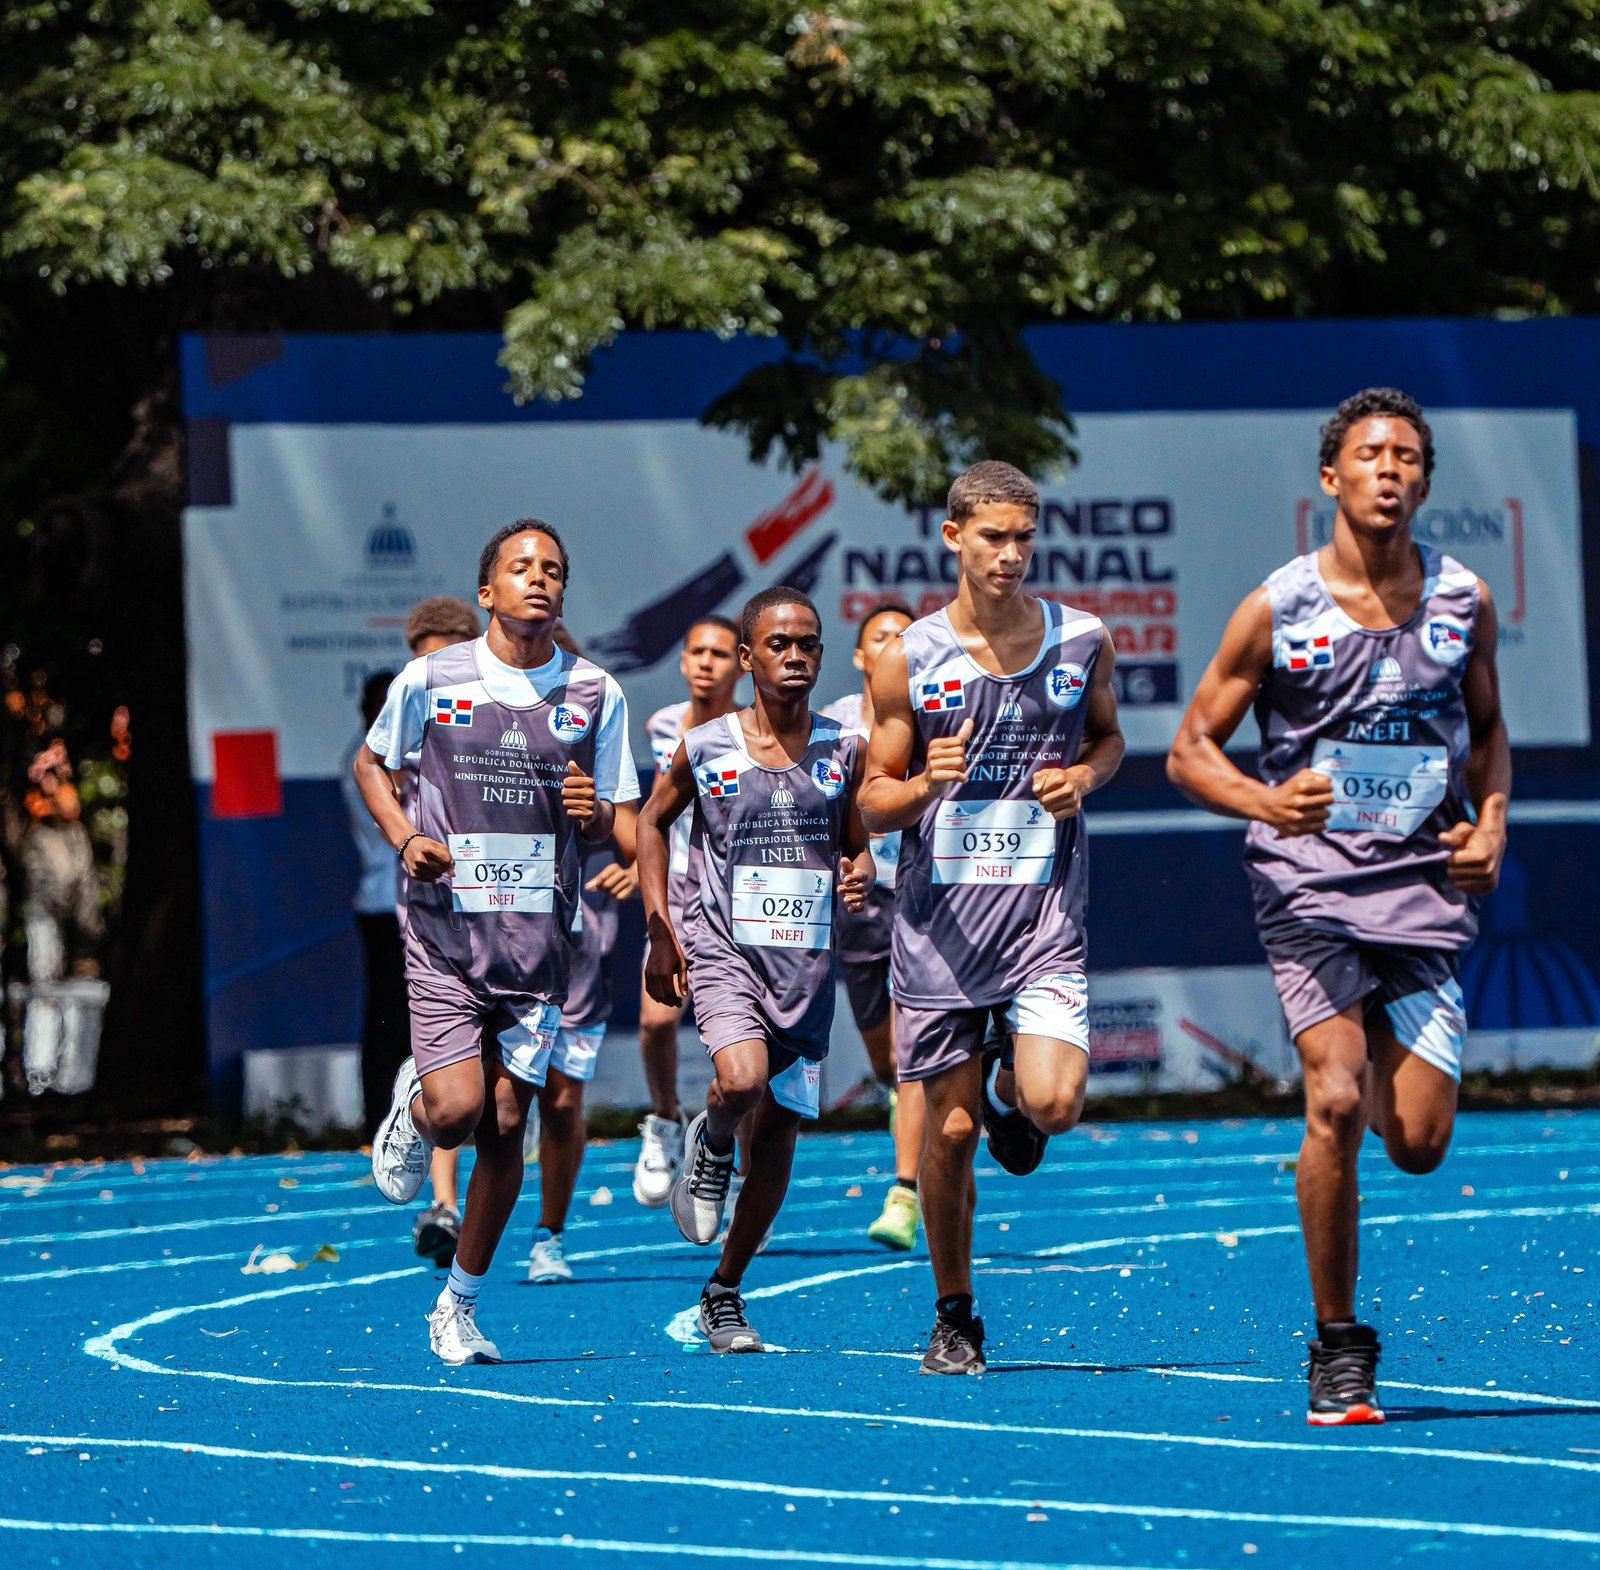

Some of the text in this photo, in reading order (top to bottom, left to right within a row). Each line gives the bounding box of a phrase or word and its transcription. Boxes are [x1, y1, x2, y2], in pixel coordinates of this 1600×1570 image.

[911, 500, 1171, 537] TNEO
[846, 548, 1175, 584] NACNAL
[1001, 733, 1066, 743] DOMINICANA
[485, 749, 519, 758] GOBIERNO
[996, 752, 1010, 760] DE
[1012, 750, 1063, 760] EDUCACIÓN
[453, 754, 569, 773] REPÚBLICA DOMINICANA
[454, 772, 504, 784] MINISTERIO
[505, 776, 517, 785] DE
[970, 764, 1028, 781] INEFI
[482, 786, 535, 805] INEFI
[1343, 777, 1412, 801] 0360
[728, 819, 780, 831] REPÚBLICA
[1356, 811, 1397, 827] INEFI
[729, 832, 830, 848] MINISTERIO DE DUCACIÓ
[963, 832, 1021, 853] 0339
[474, 863, 523, 882] 0365
[975, 865, 1013, 878] INEFI
[488, 894, 515, 905] INEFI
[762, 897, 814, 918] 0287
[771, 928, 804, 942] INEFI
